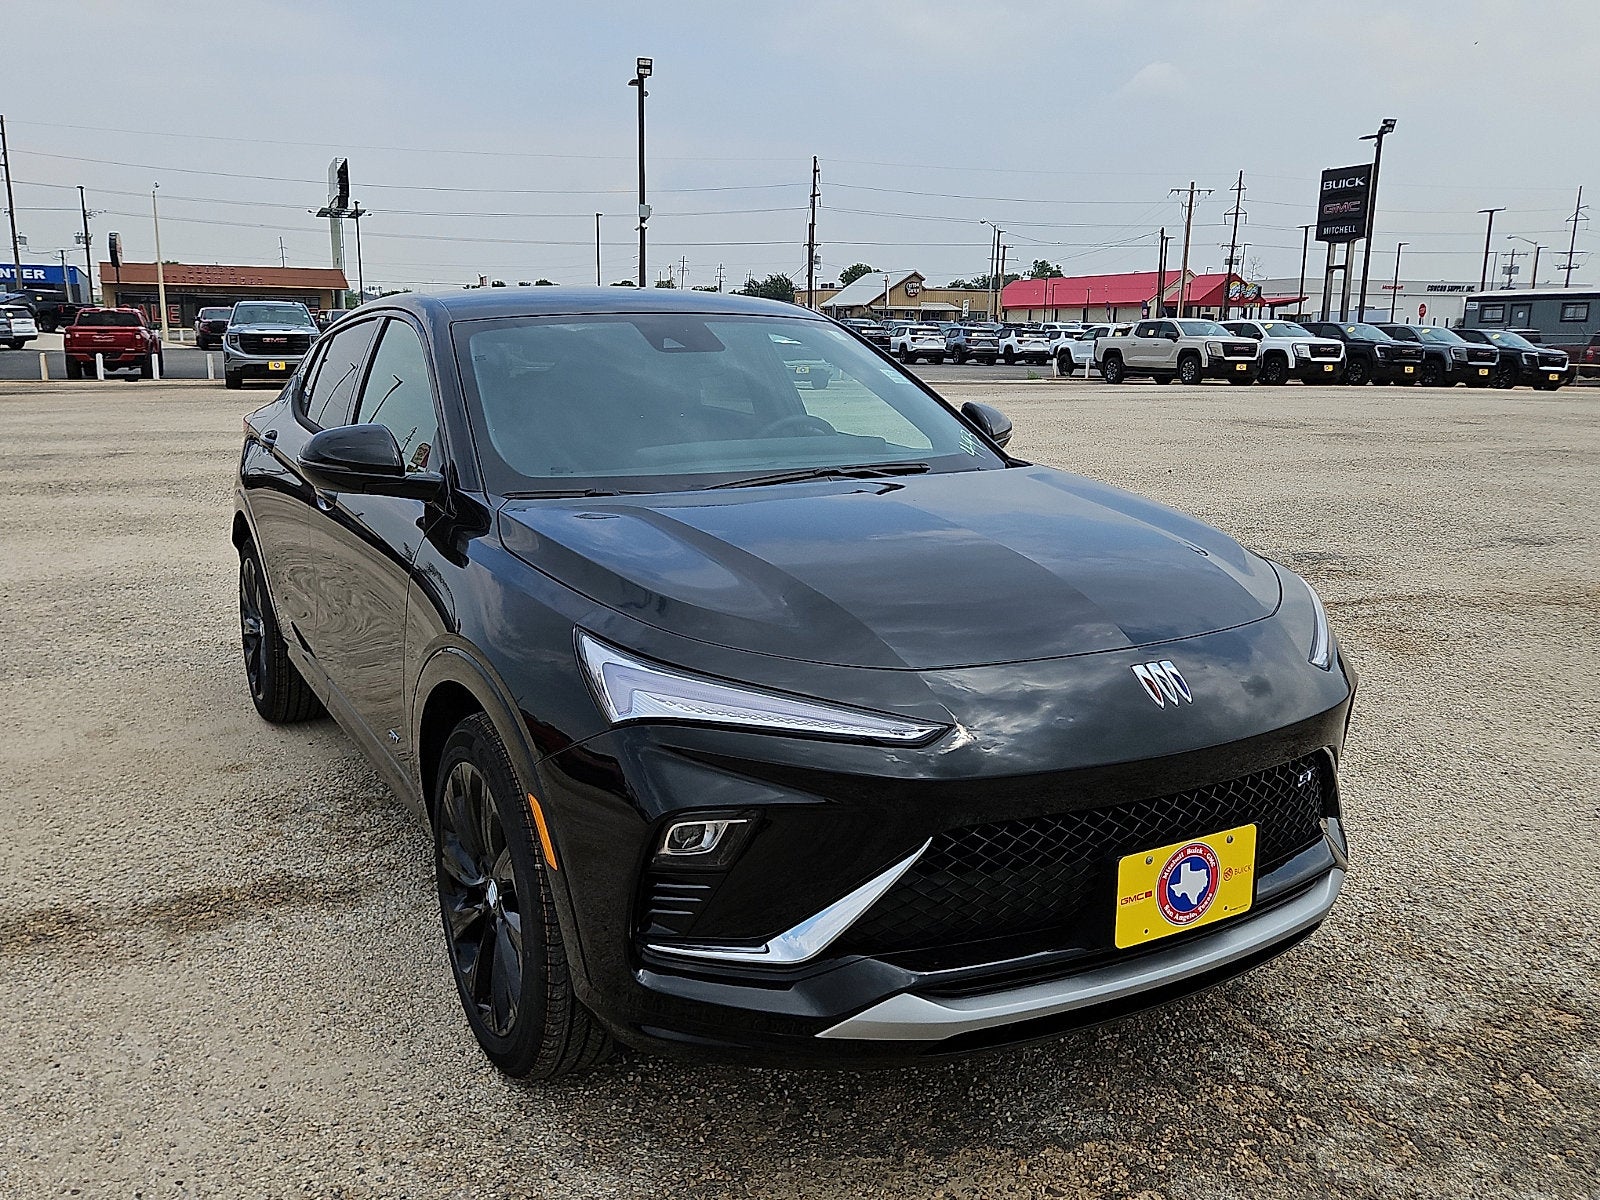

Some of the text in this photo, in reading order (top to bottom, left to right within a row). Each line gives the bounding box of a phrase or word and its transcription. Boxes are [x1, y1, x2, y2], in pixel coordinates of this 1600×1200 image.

[1322, 176, 1366, 191] BUICK
[1323, 200, 1361, 215] GMC
[1322, 225, 1357, 235] MITCHELL
[1162, 847, 1216, 879] Mitchell Buick GMC
[1234, 864, 1252, 876] BUICK
[1120, 892, 1145, 906] GMC
[1163, 904, 1174, 917] San
[1198, 892, 1213, 913] Texas
